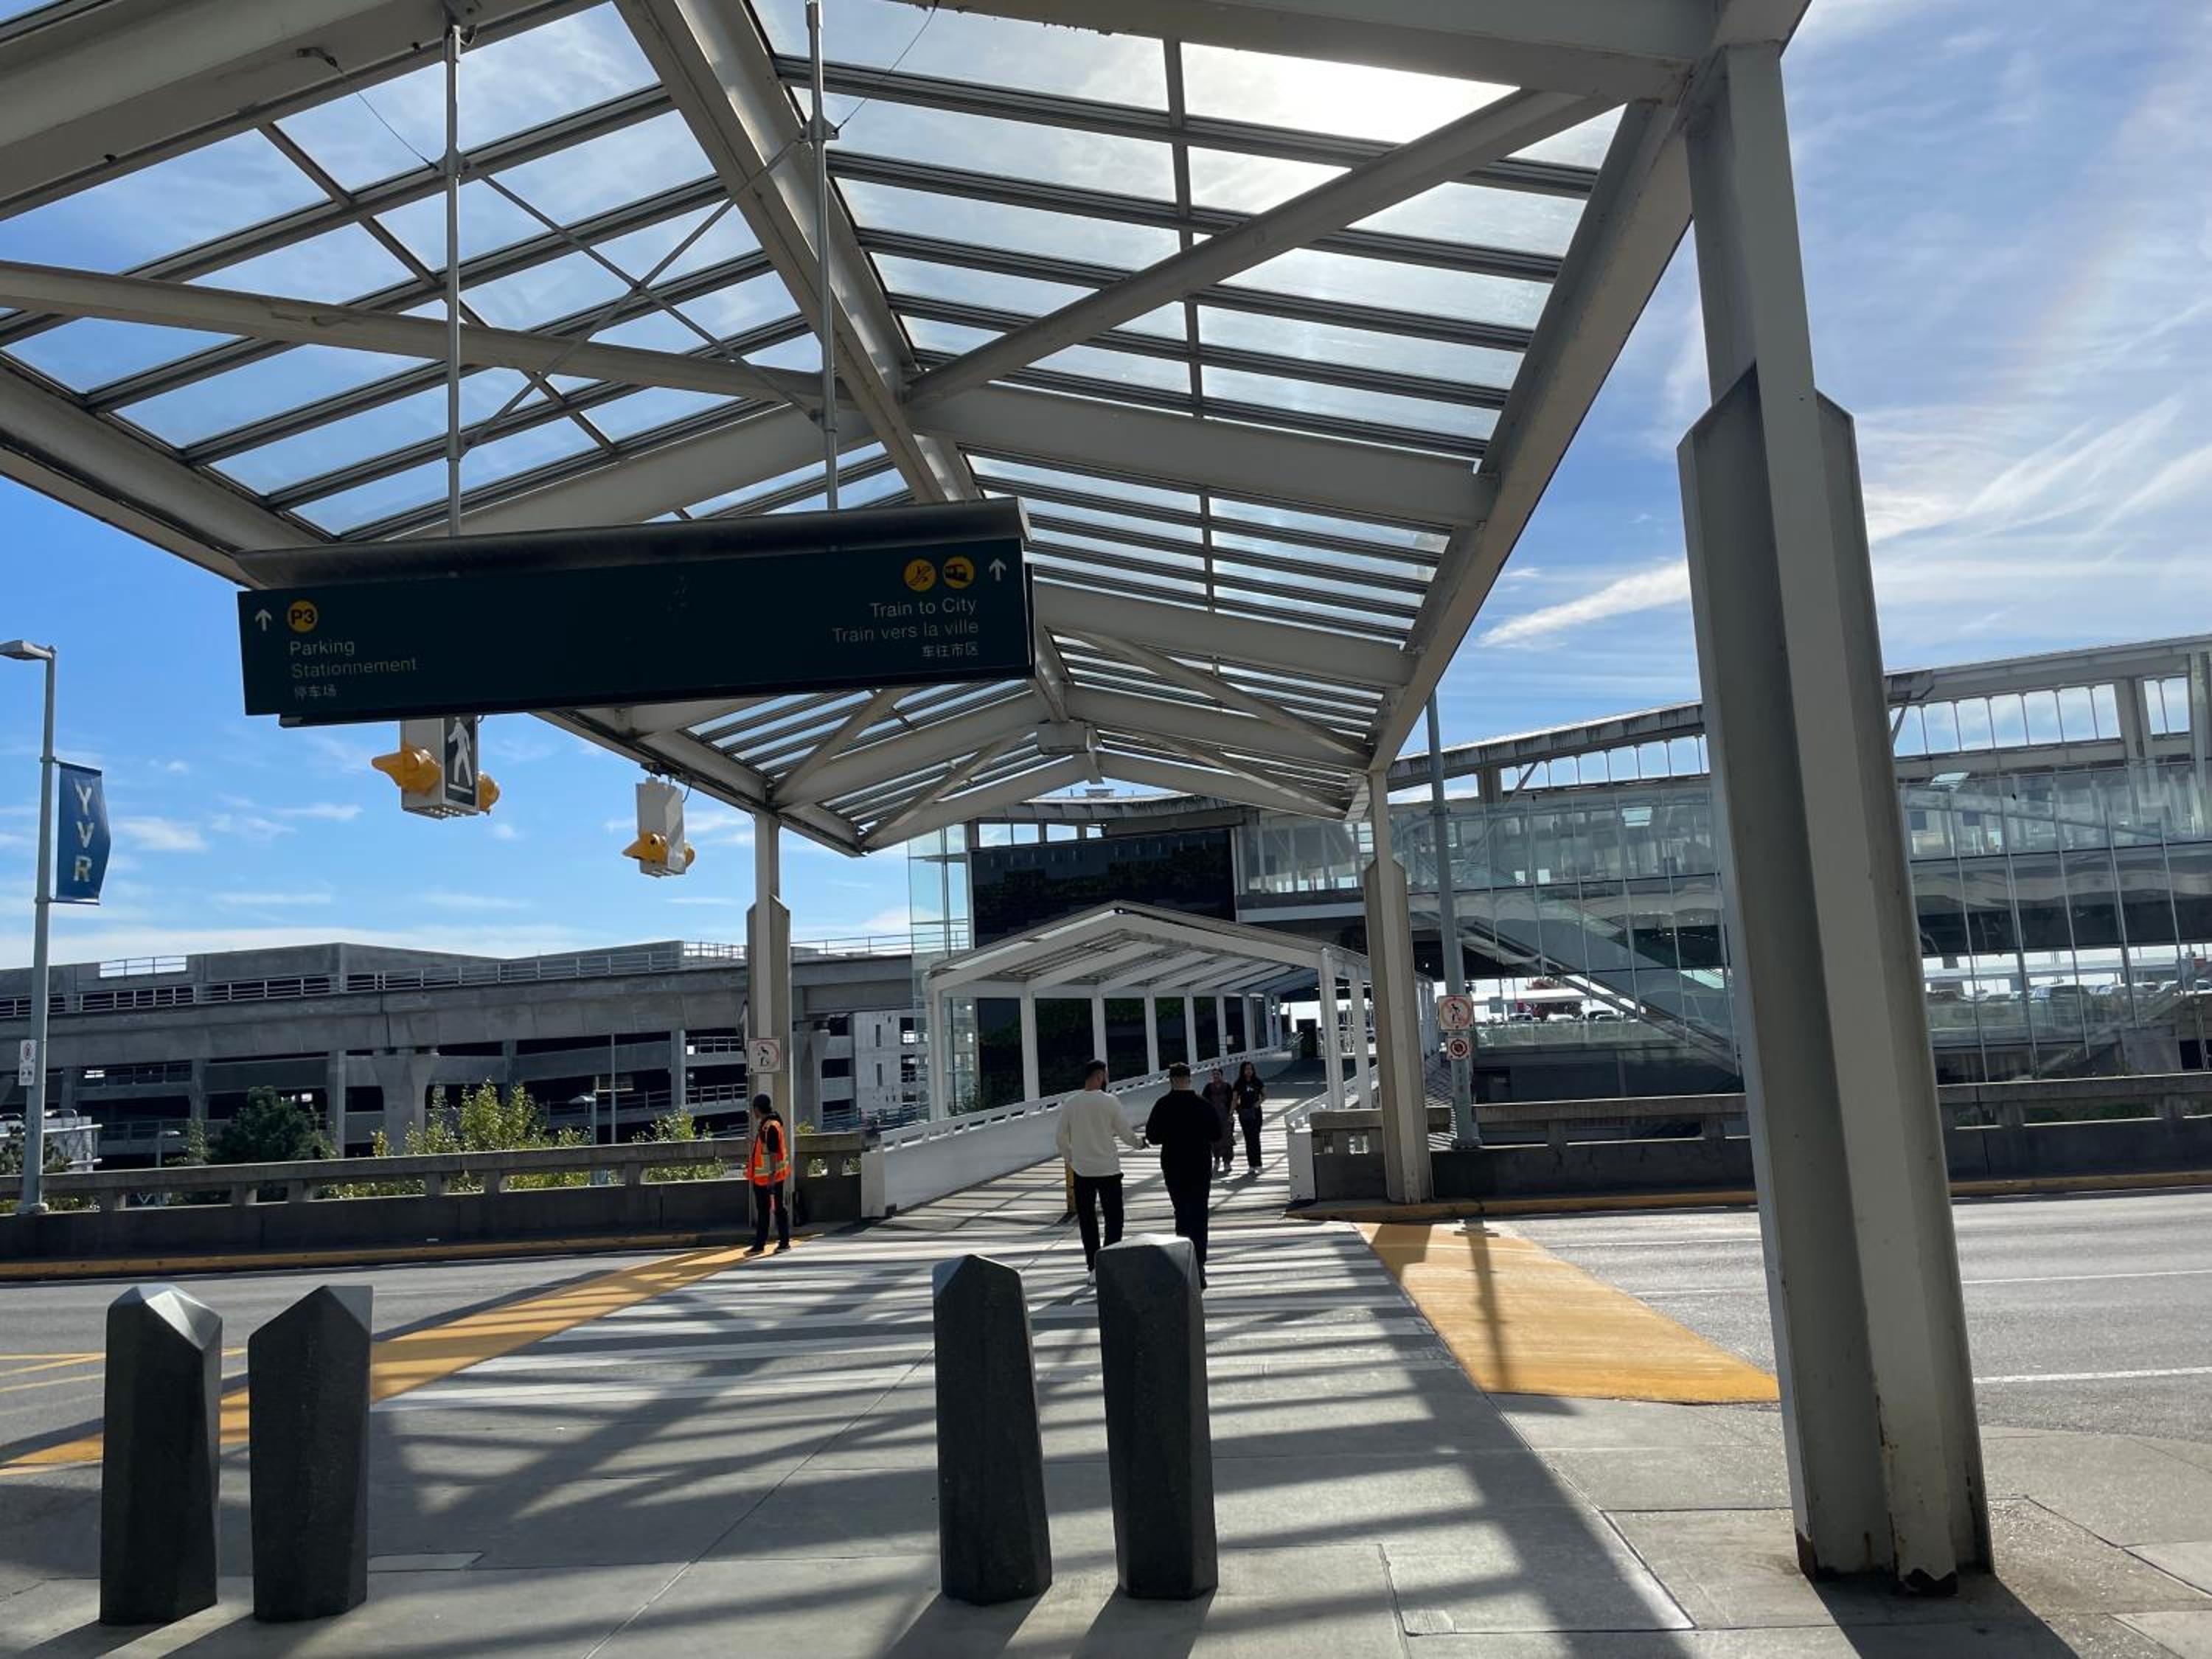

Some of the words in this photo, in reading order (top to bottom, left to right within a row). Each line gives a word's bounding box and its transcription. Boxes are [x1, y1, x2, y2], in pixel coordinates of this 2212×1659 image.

[291, 609, 315, 625] P3
[870, 602, 912, 618] Train
[919, 601, 936, 614] to
[942, 597, 977, 615] City
[832, 627, 874, 643] Train
[881, 625, 918, 639] vers
[924, 621, 939, 636] la
[945, 619, 978, 636] ville
[290, 640, 355, 655] Parking
[292, 657, 417, 678] Stationnement
[294, 683, 338, 701] 停车场
[74, 783, 94, 883] YVR
